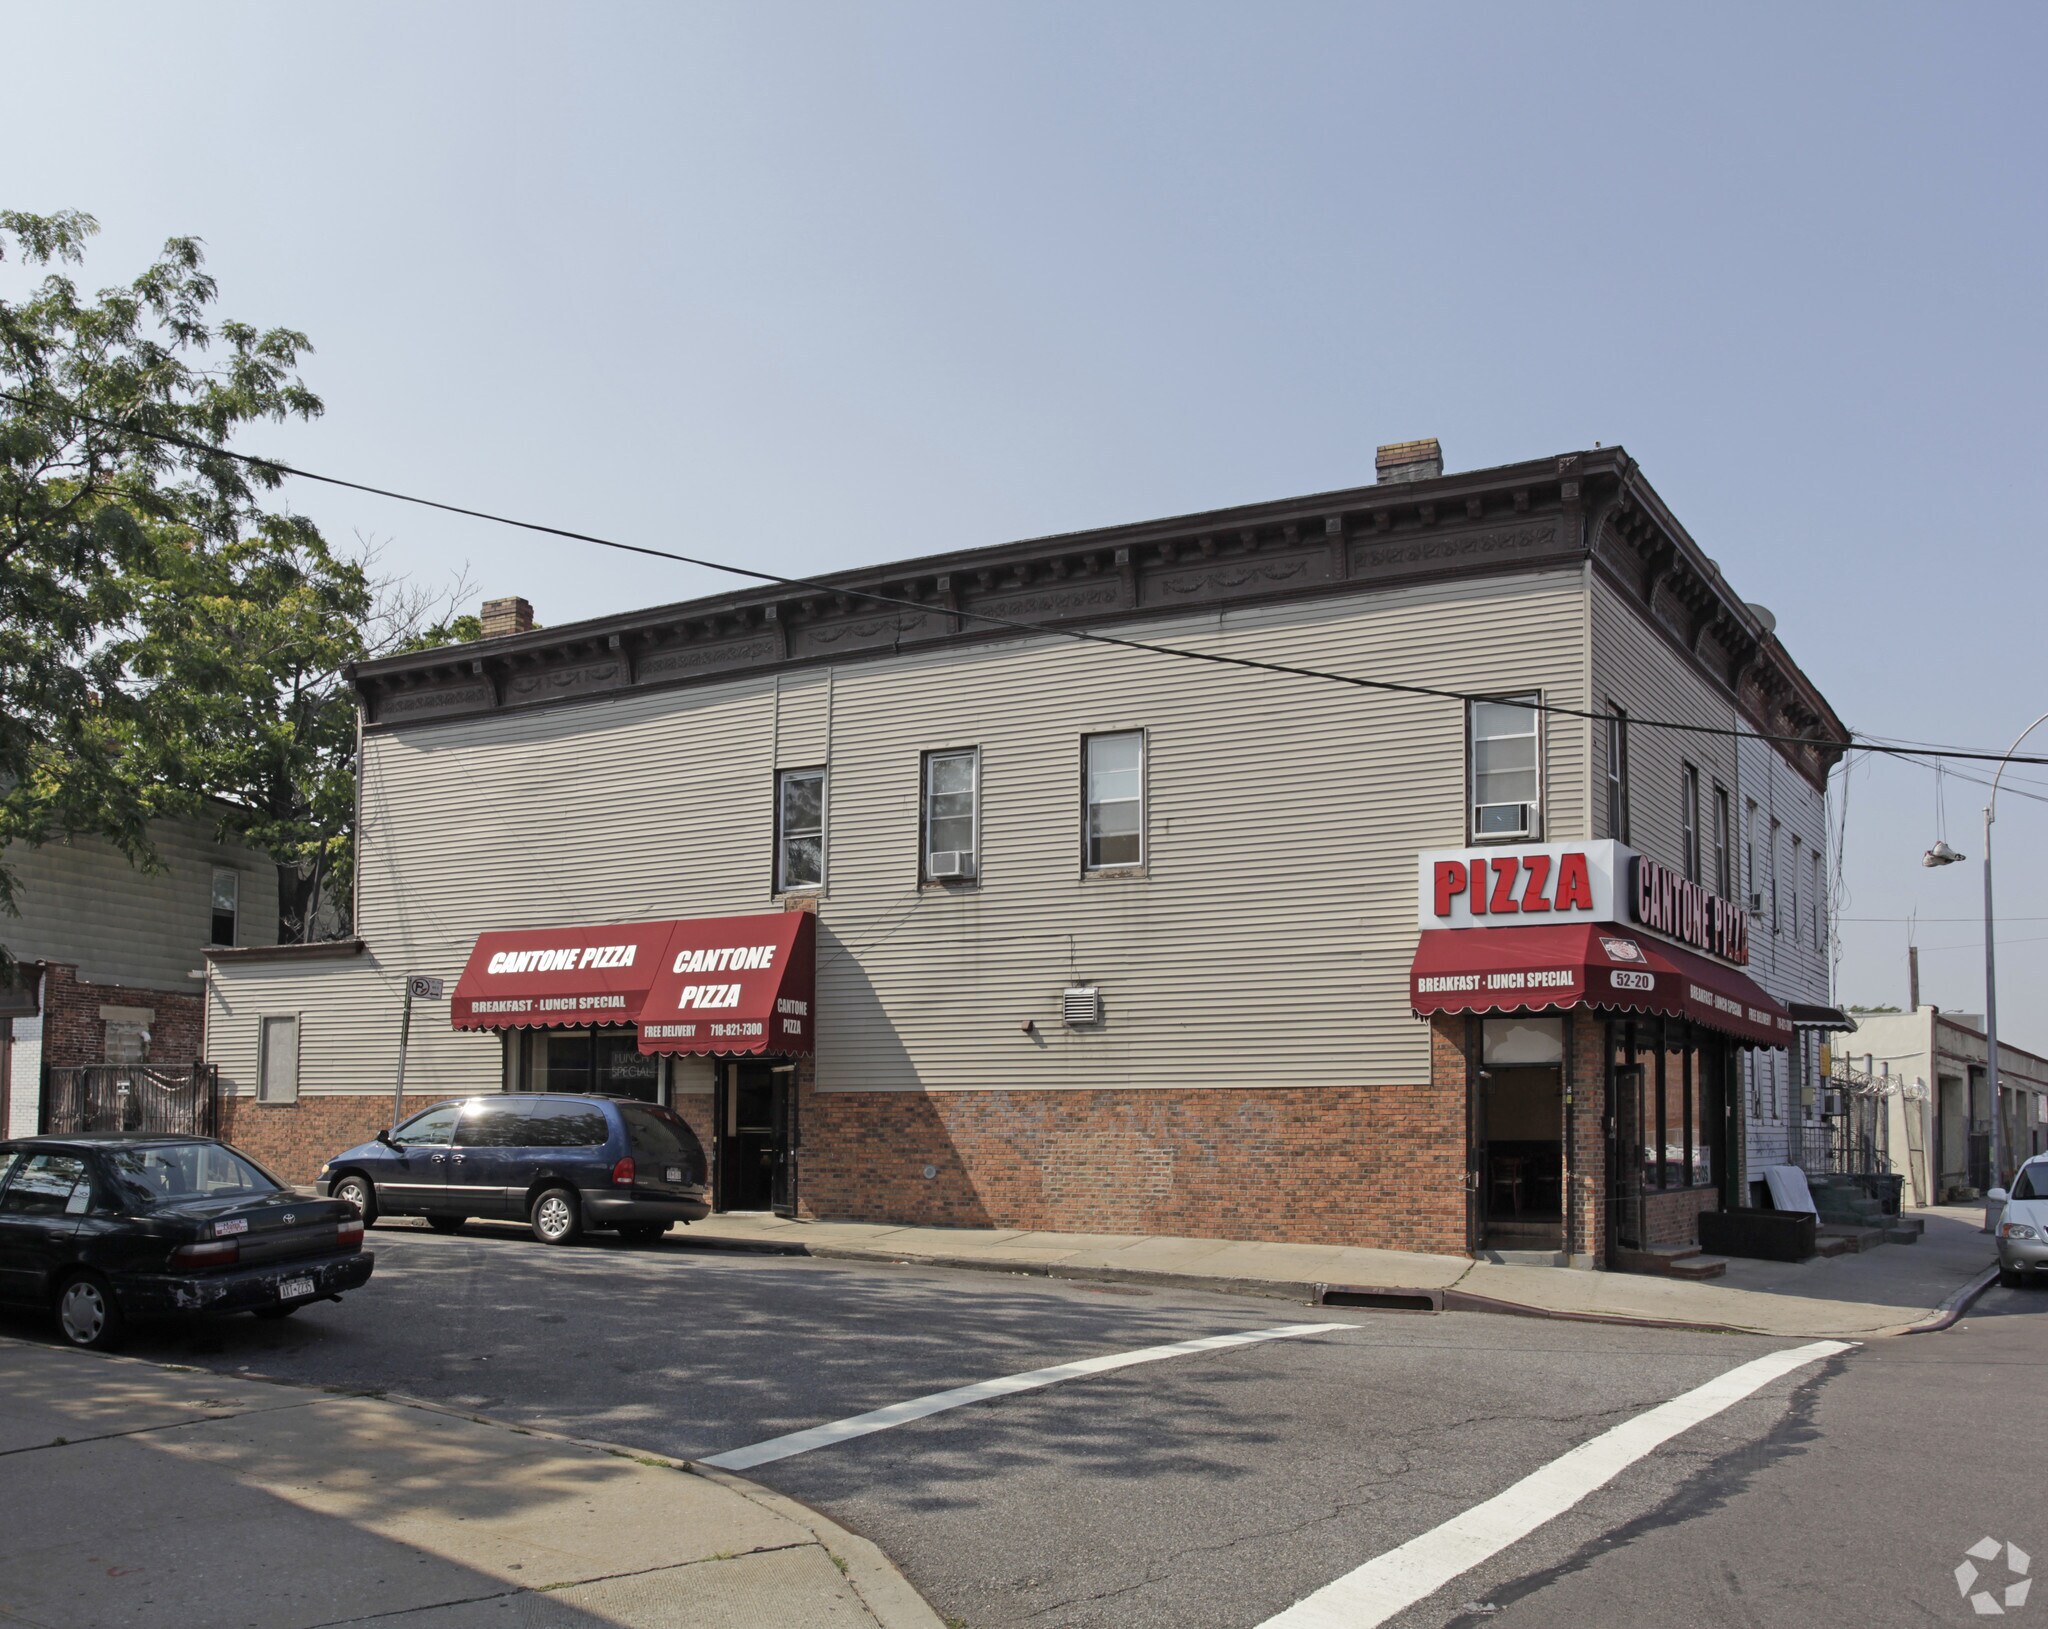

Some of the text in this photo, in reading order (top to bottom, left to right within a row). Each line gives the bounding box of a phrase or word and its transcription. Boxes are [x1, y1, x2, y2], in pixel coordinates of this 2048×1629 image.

[1434, 853, 1593, 917] PIZZA
[1638, 855, 1749, 966] CANTONE PIZZA
[487, 945, 638, 975] CANTONE PIZZA
[672, 945, 777, 974] CANTONE
[1418, 970, 1574, 993] BREAKFAST LUNCH SPECIAL
[1616, 973, 1649, 989] 52-20
[471, 995, 626, 1013] BREAKFAST LUNCH SPECIAL
[677, 984, 742, 1009] PIZZA
[777, 998, 808, 1016] CANTONE
[644, 1022, 763, 1037] FREE DELIVERY 718-821-7300
[783, 1019, 802, 1034] PIZZA
